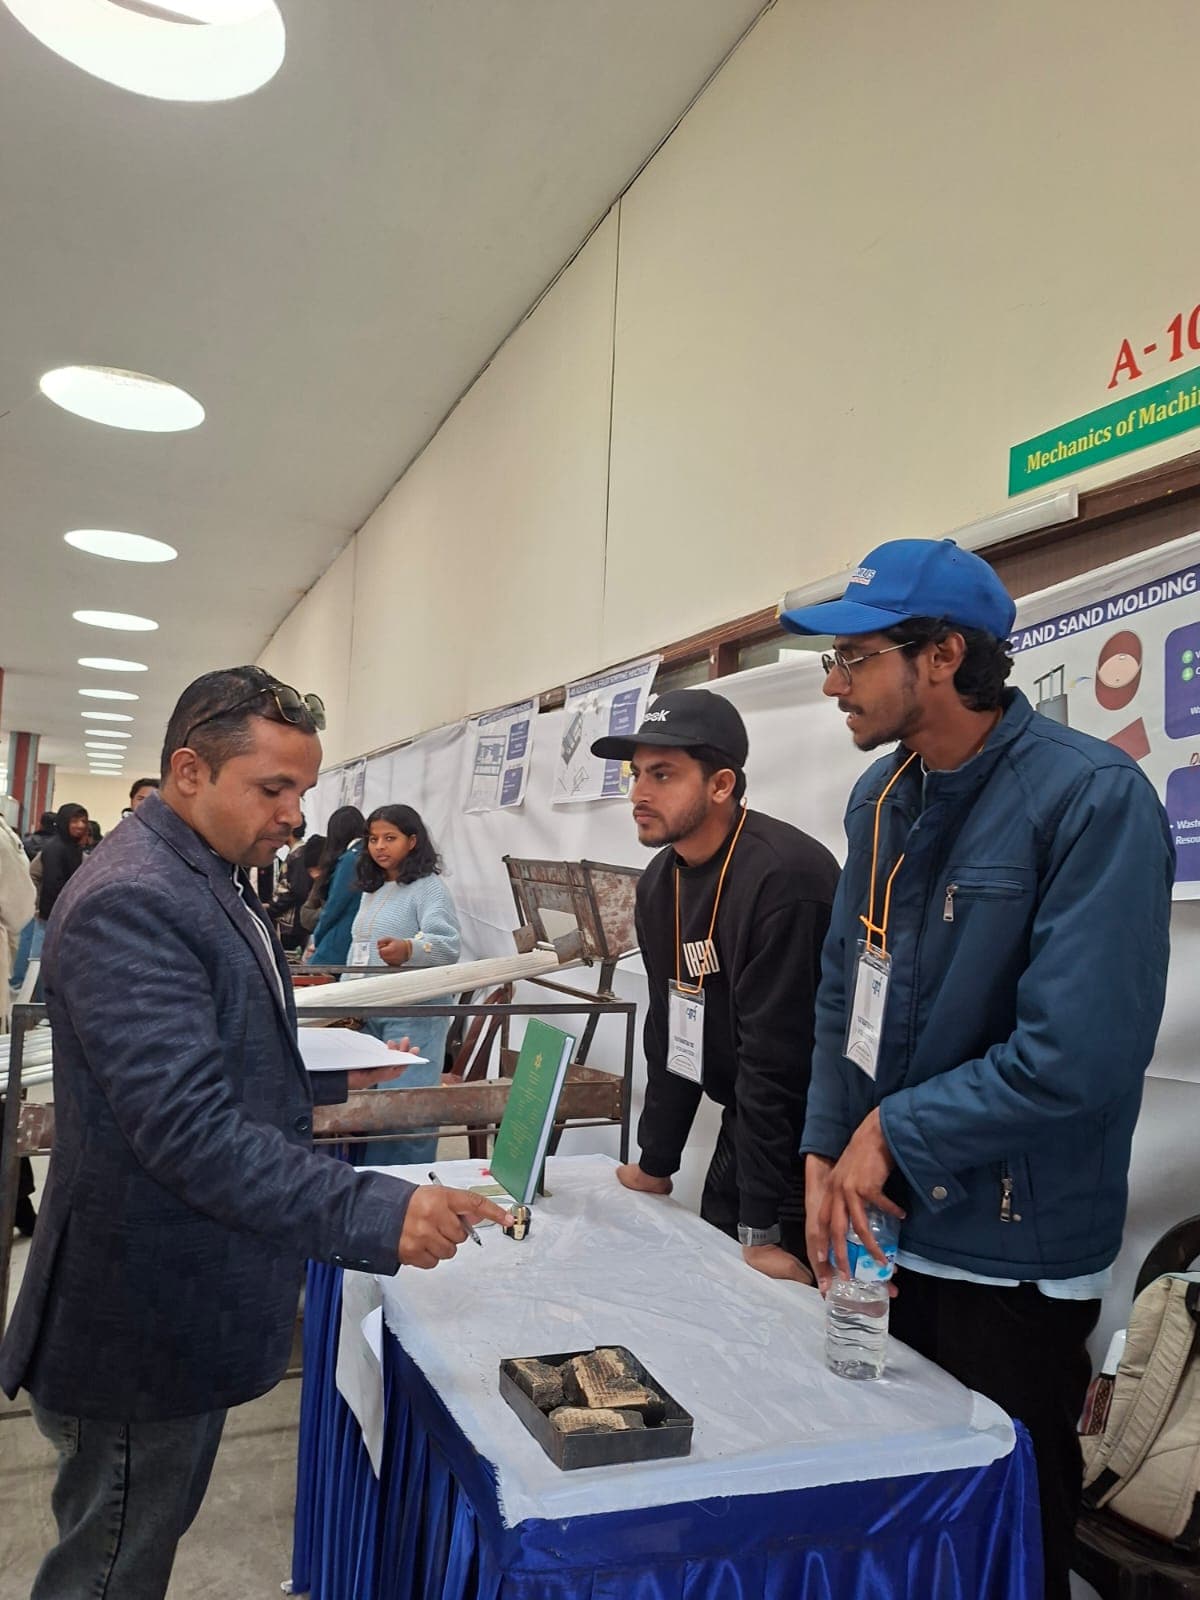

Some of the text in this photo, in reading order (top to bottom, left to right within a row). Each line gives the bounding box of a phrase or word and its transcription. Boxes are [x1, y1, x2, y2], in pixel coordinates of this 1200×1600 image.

[1026, 385, 1200, 474] Mechanics of Machi
[1020, 624, 1056, 650] AND
[1058, 607, 1104, 636] SAND
[1106, 572, 1197, 620] MOLDING
